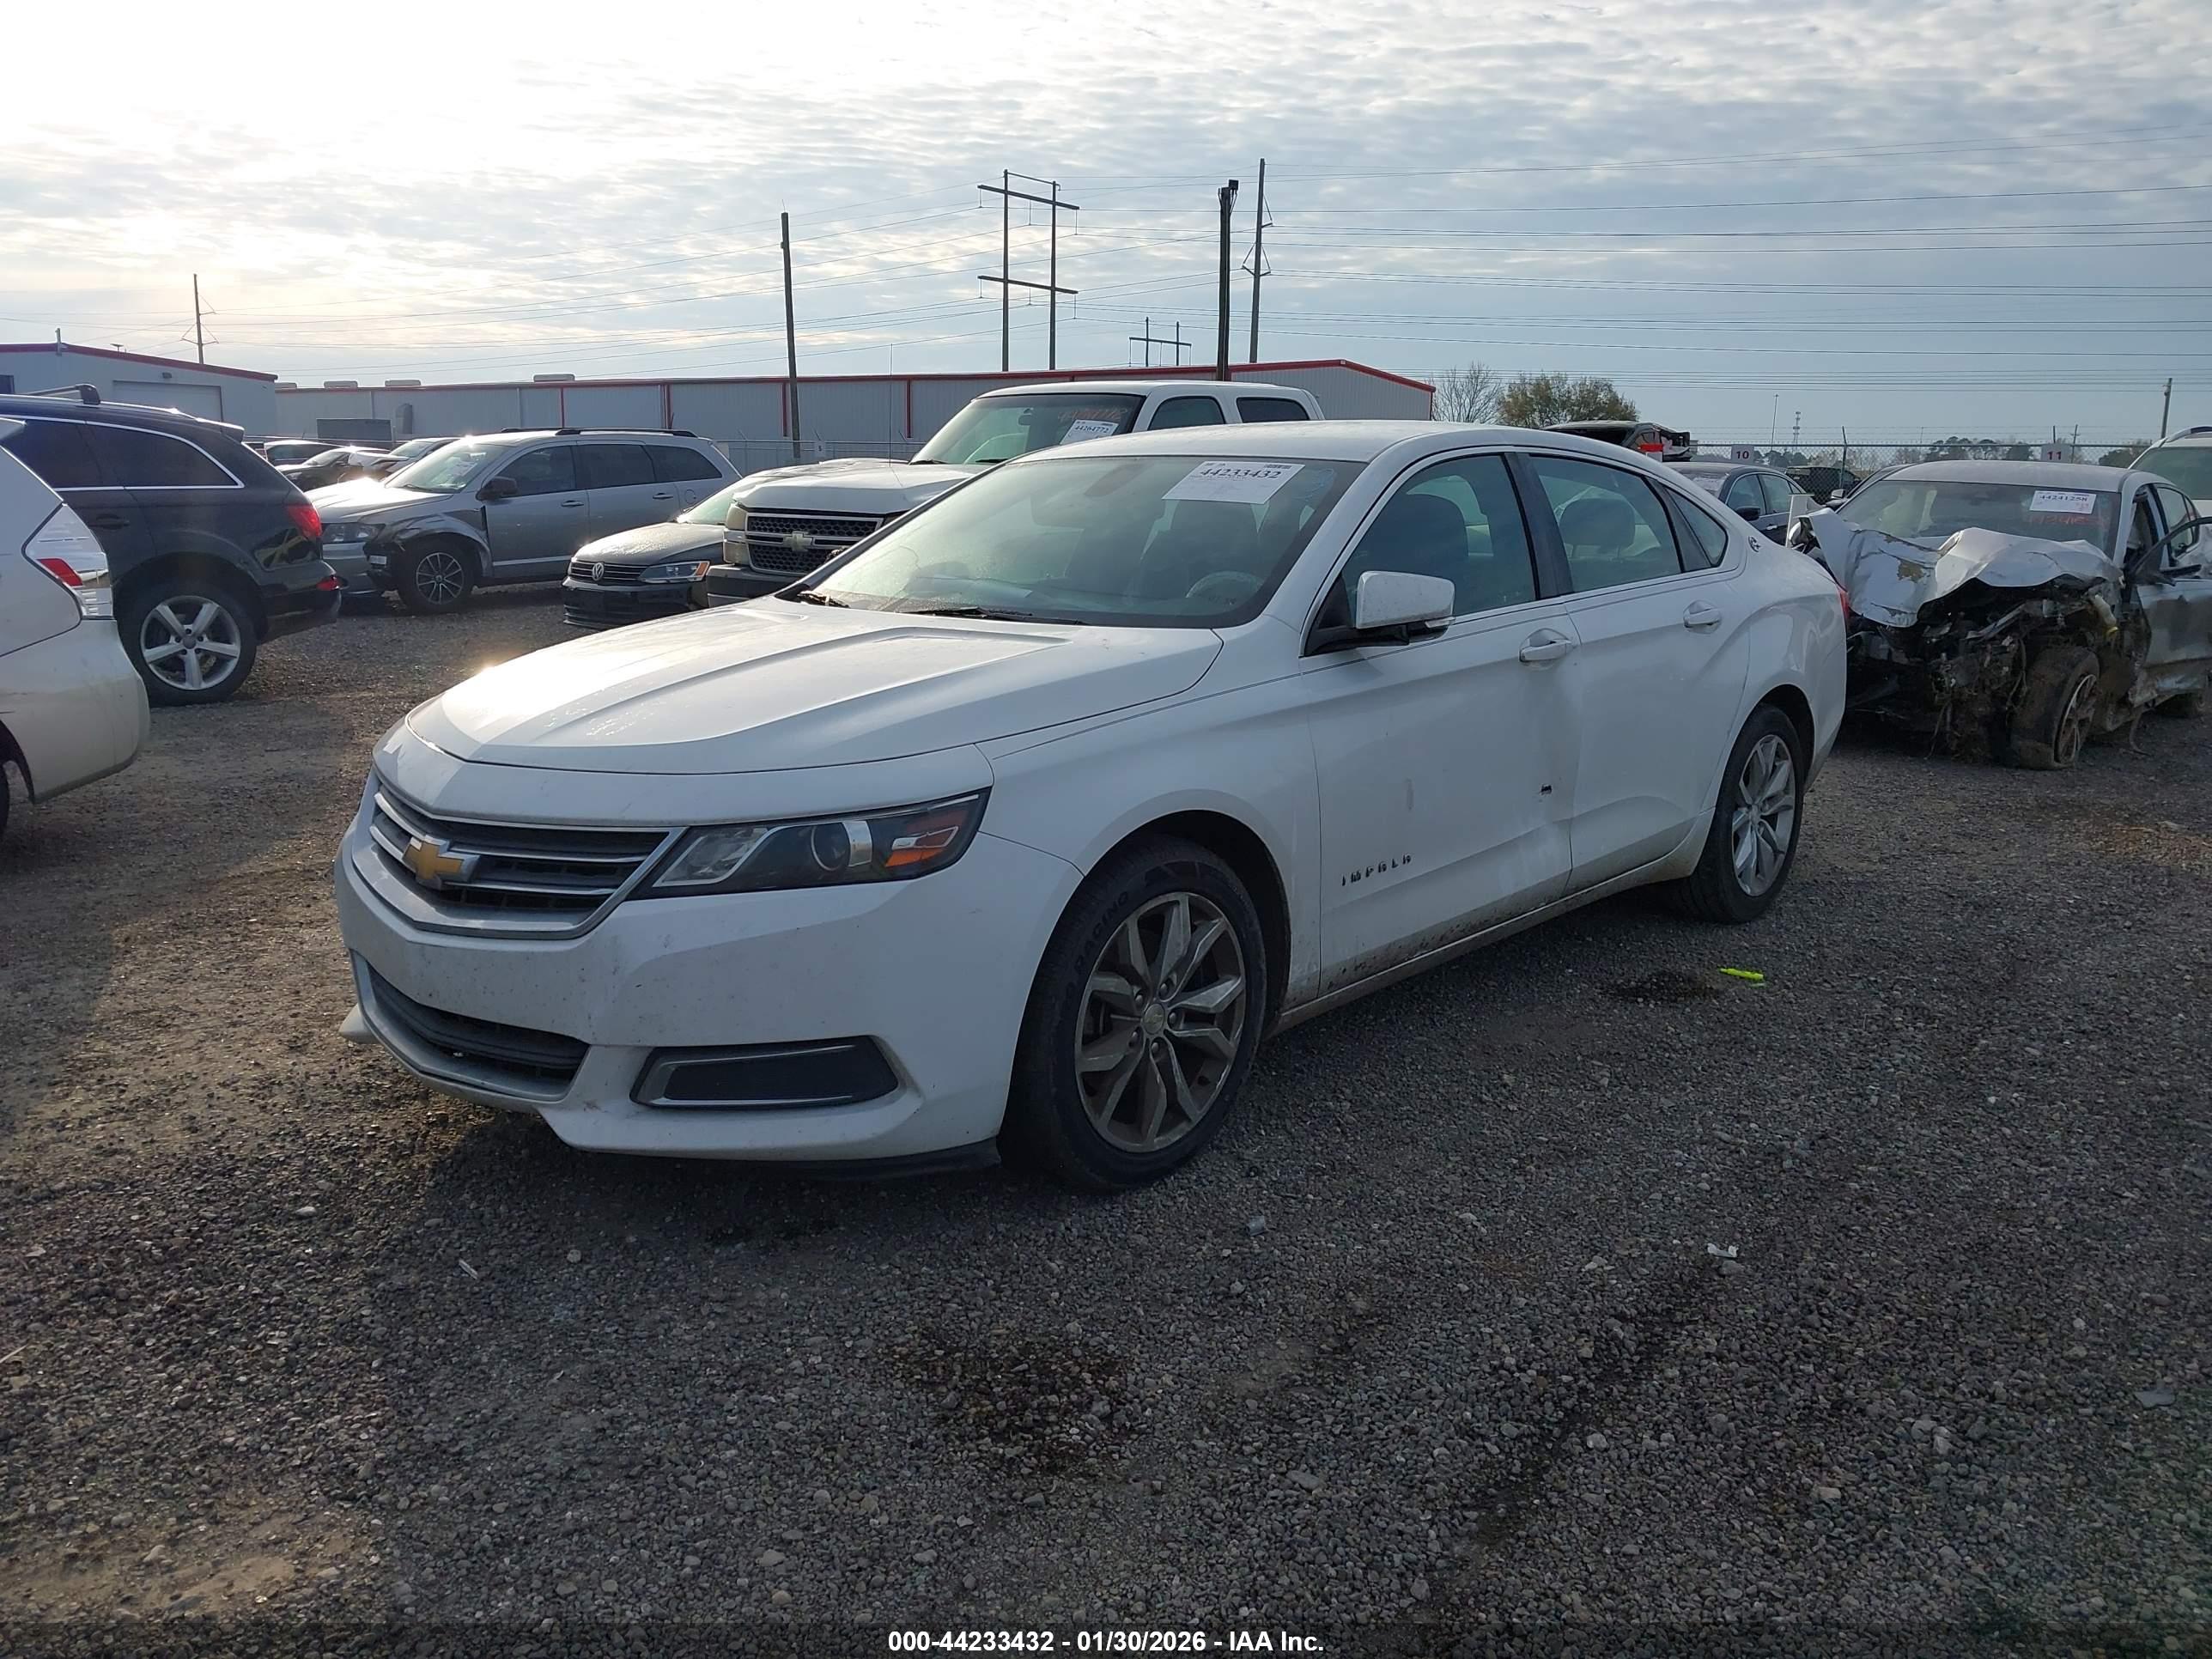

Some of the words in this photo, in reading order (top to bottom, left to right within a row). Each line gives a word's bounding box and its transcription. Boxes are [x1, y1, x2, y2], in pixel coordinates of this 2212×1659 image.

[2047, 452, 2061, 460] 11
[1200, 468, 1282, 479] 44233432
[1341, 854, 1412, 886] IMPALA
